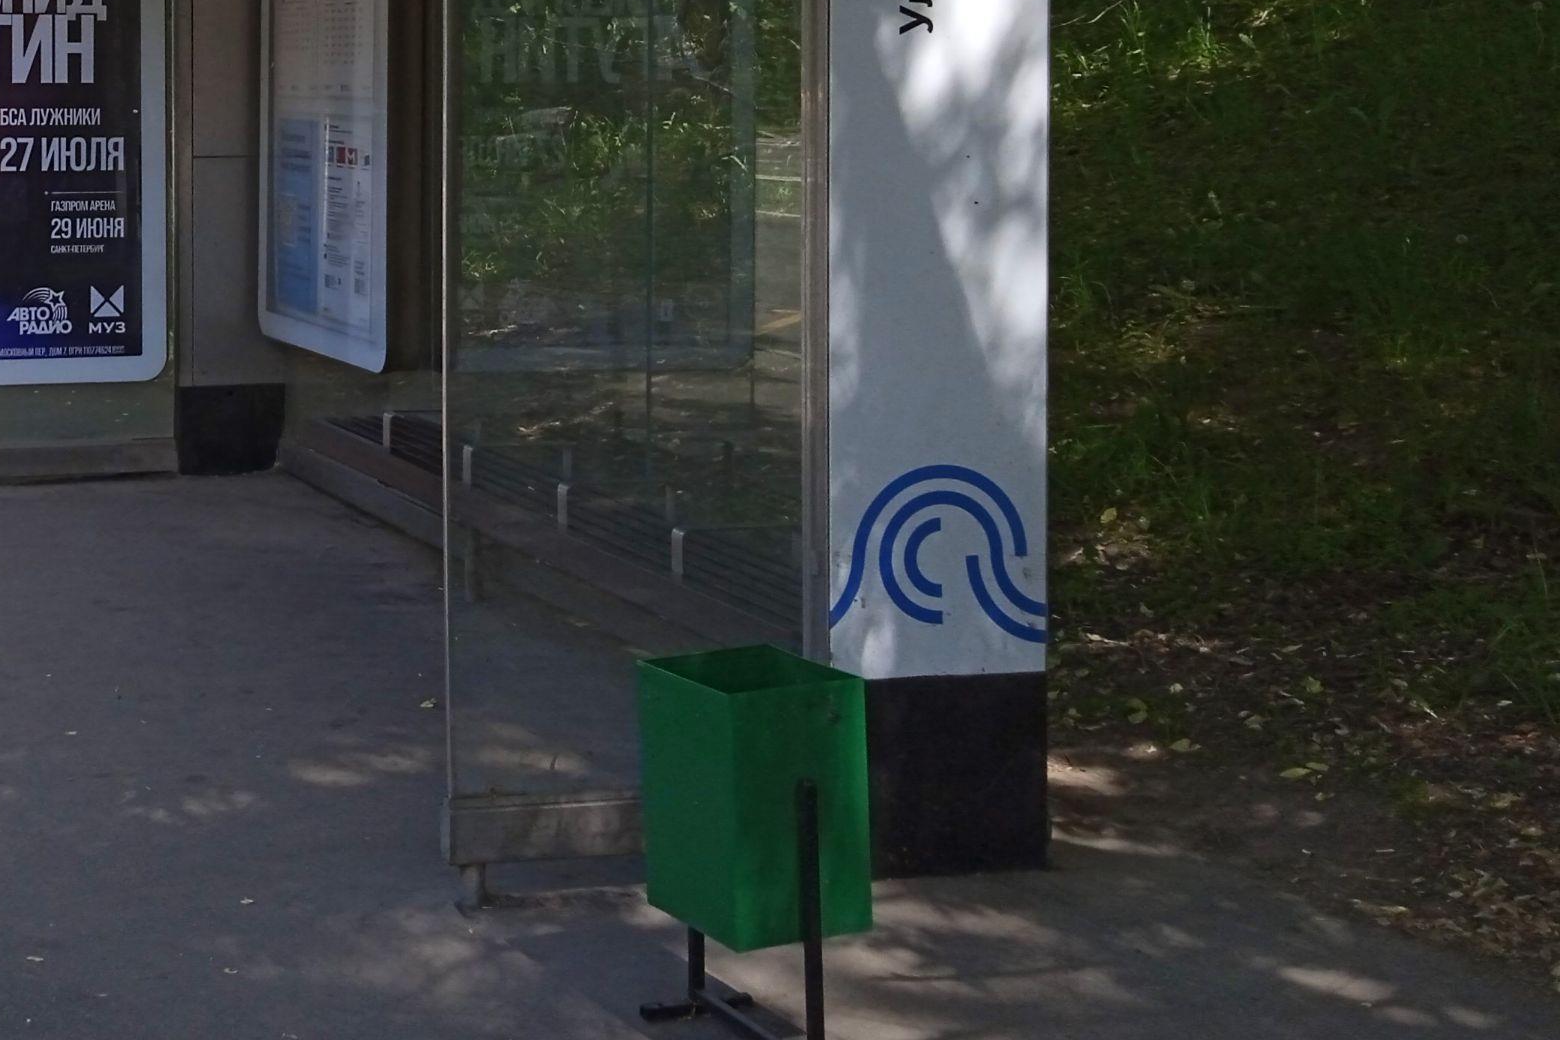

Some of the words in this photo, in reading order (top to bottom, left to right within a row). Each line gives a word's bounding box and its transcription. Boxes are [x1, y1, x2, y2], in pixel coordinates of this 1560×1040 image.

[0, 108, 27, 126] БСА
[29, 108, 101, 126] ЛУЖНИКИ
[0, 137, 34, 172] 27
[41, 137, 125, 172] ИЮЛЯ
[51, 200, 89, 212] ГАЗПРОМ
[90, 200, 116, 211] АРЕНА
[51, 218, 72, 239] 29
[76, 217, 125, 238] ИЮНЯ
[7, 306, 50, 321] АВТО
[19, 320, 73, 335] РАДИО
[88, 321, 126, 334] МУЗ
